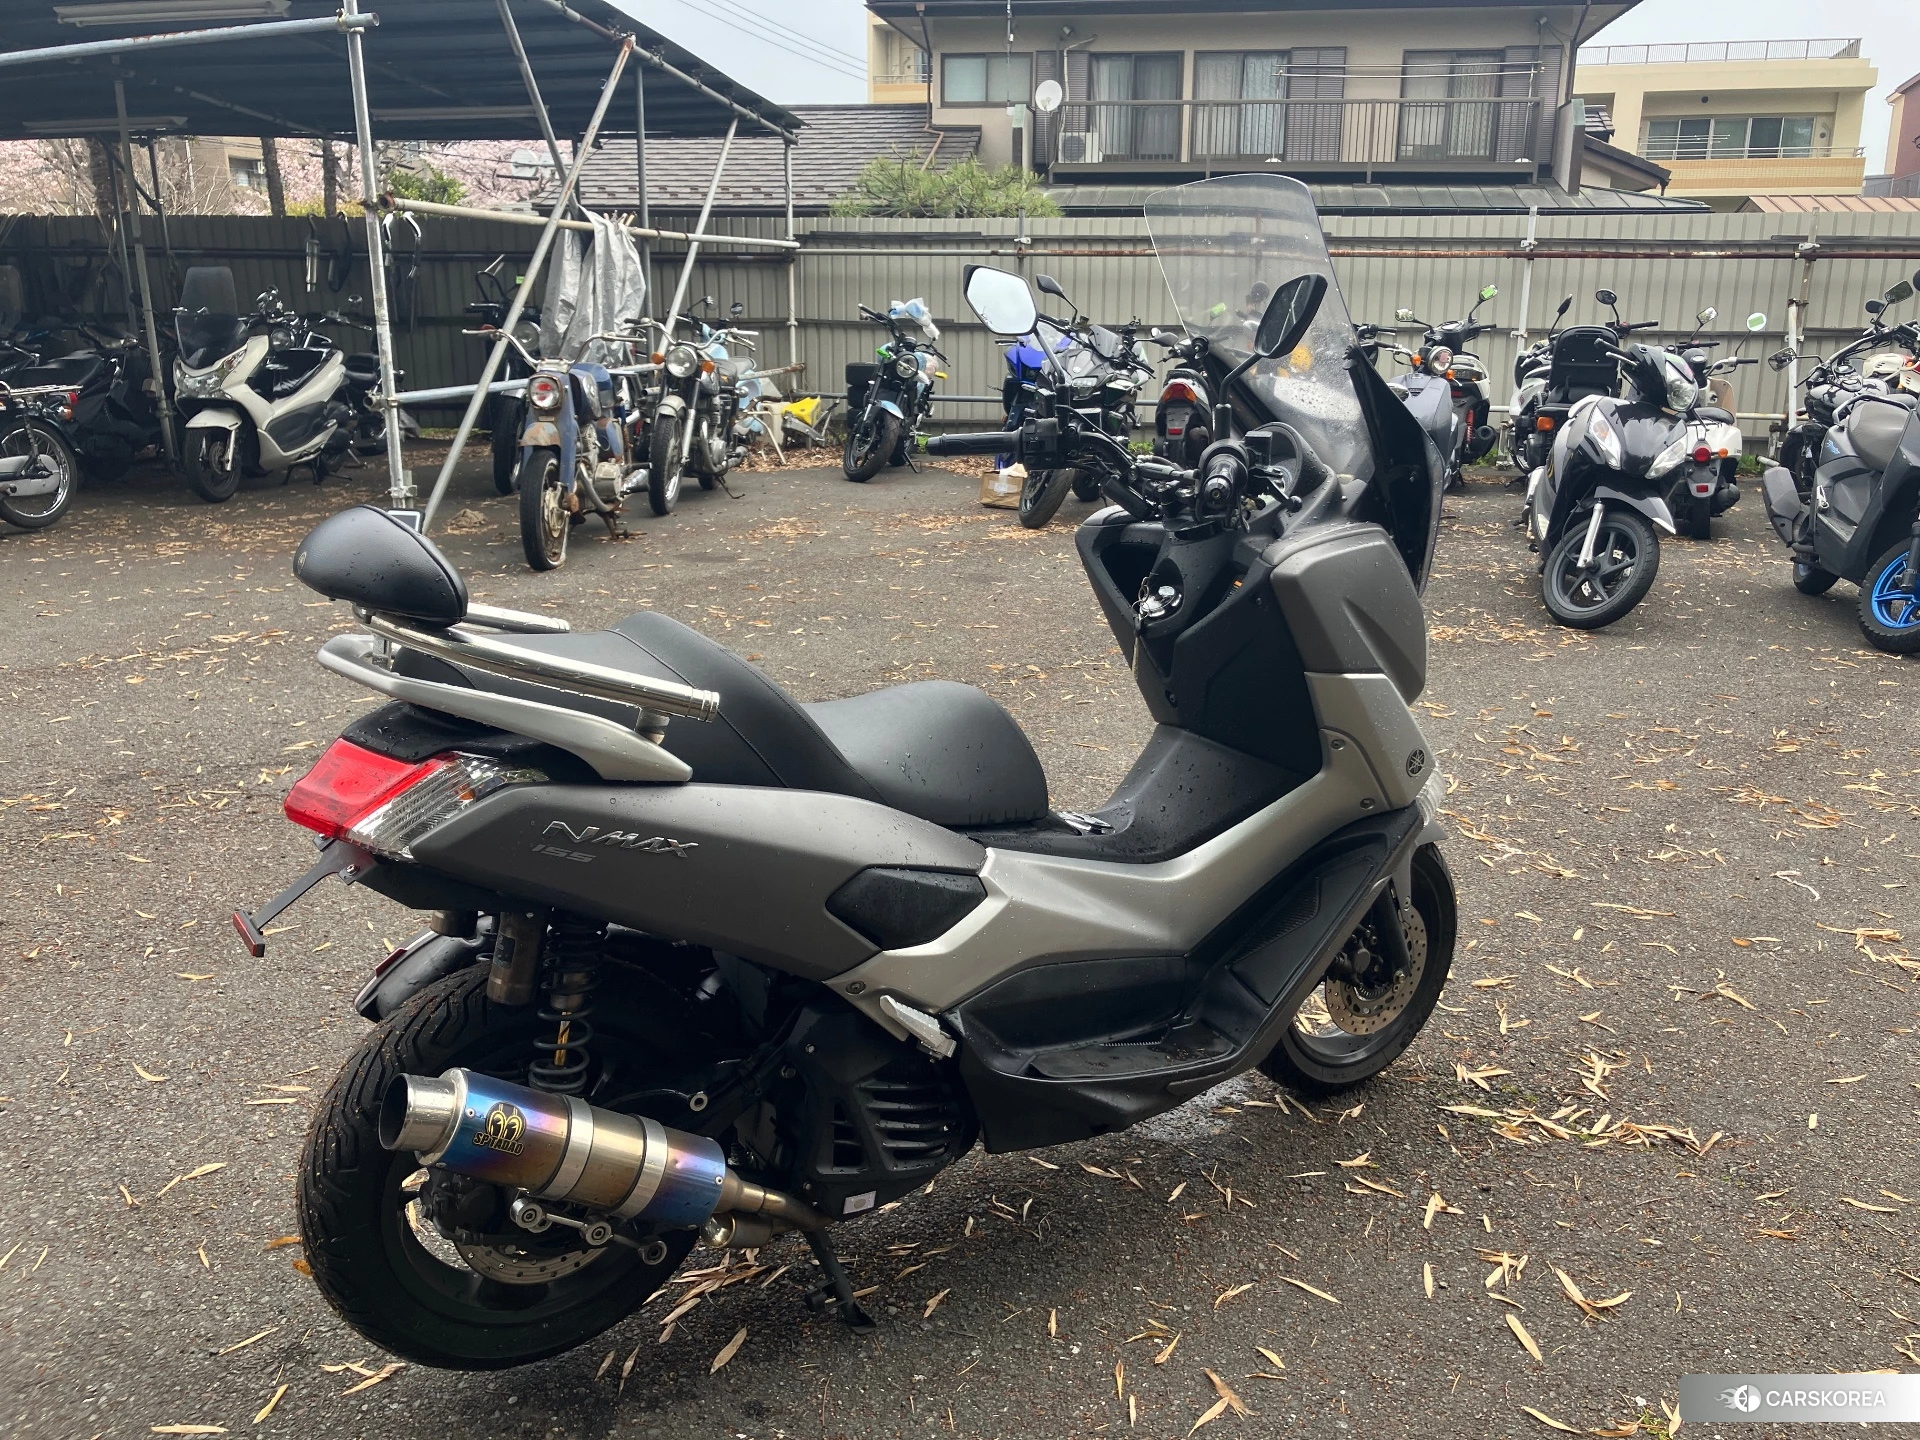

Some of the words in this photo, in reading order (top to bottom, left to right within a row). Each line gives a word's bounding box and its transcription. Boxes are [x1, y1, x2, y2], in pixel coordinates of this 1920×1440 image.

[542, 820, 699, 858] NMAX
[531, 844, 597, 863] 155
[474, 1132, 490, 1145] SP
